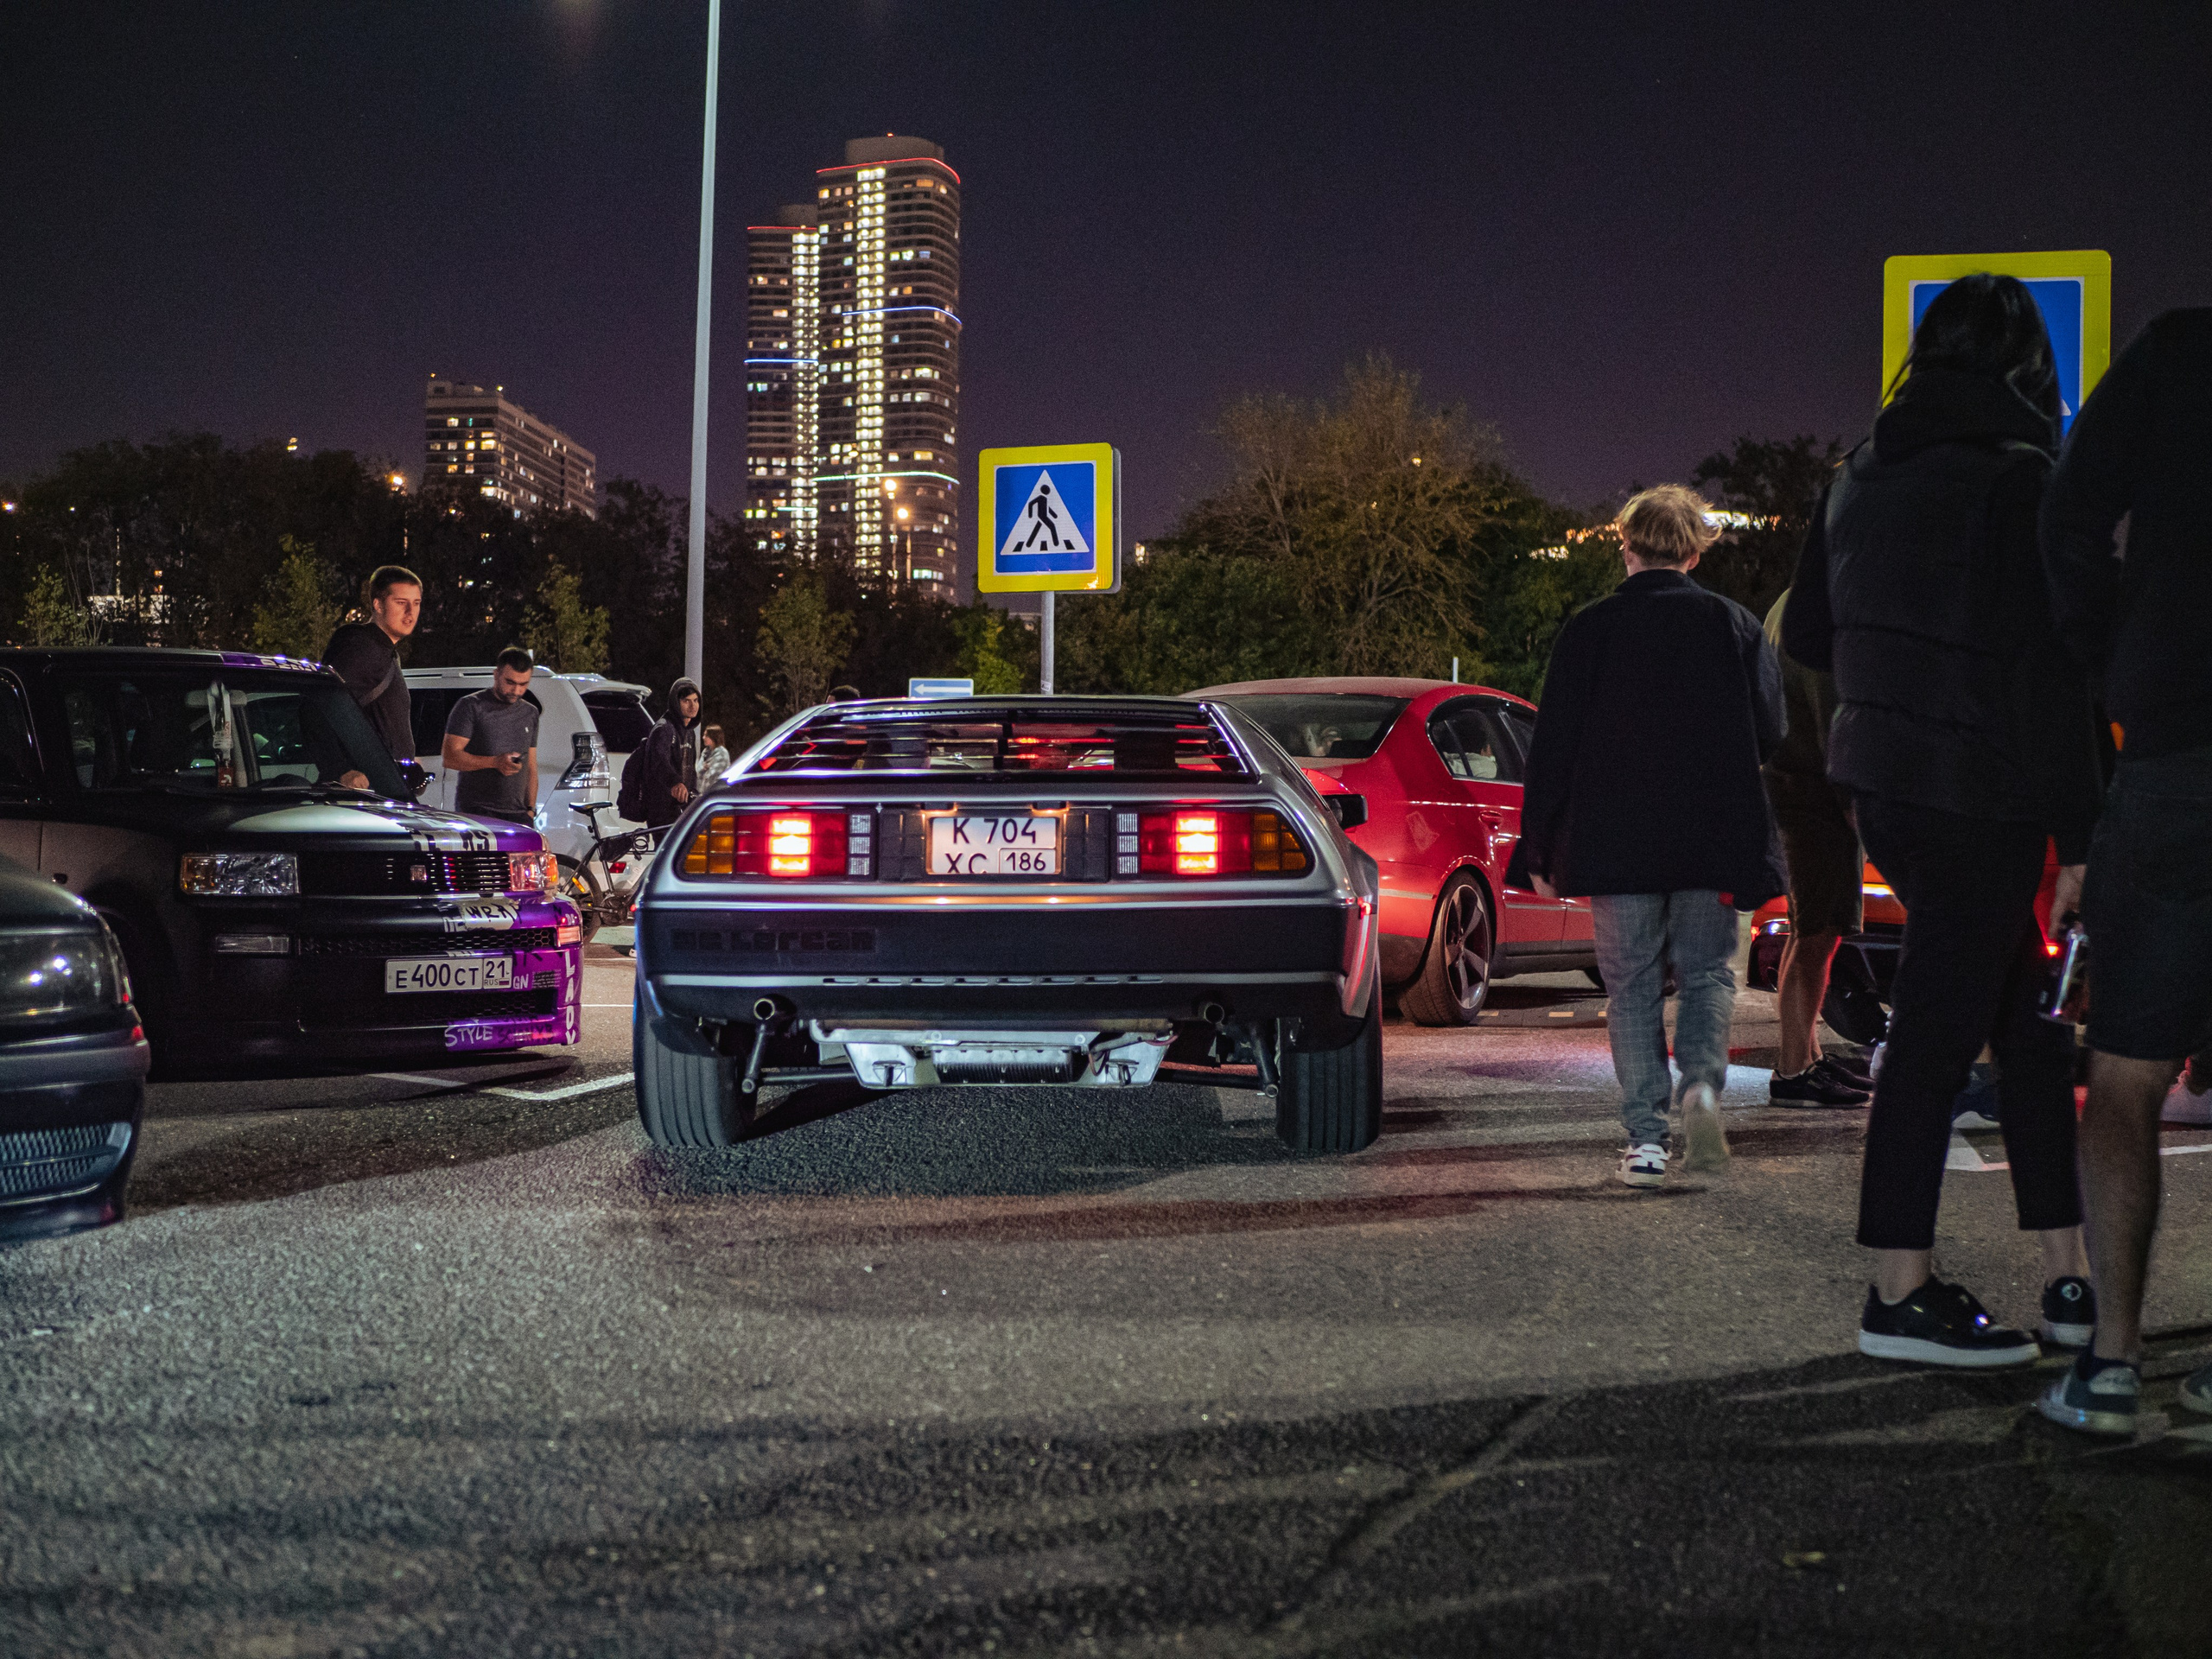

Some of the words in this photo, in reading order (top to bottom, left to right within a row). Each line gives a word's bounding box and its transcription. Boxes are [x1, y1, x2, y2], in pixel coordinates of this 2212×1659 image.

[953, 818, 969, 844] K
[983, 818, 1036, 844] 704
[945, 853, 987, 874] XC
[1006, 852, 1046, 871] 186
[486, 961, 506, 978] 21
[444, 1019, 493, 1047] STYLE
